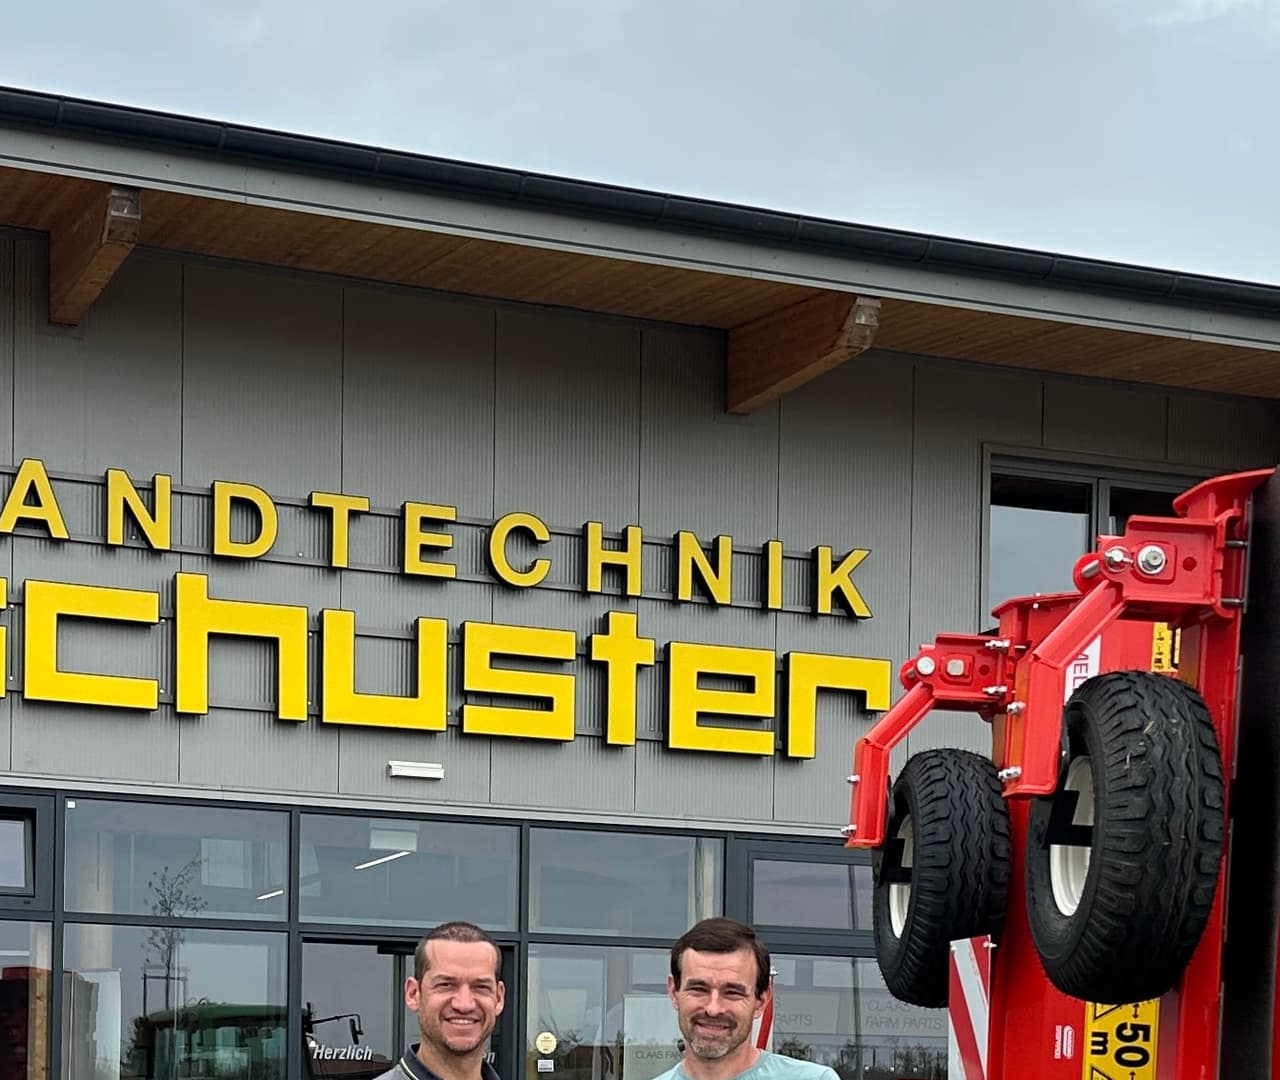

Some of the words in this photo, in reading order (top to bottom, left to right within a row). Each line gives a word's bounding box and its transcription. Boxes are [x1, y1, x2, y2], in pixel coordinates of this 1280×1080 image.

[865, 1016, 899, 1030] FARM
[903, 1017, 942, 1031] PARTS
[313, 1043, 373, 1061] Herzlich
[1090, 1031, 1109, 1056] m
[1115, 1021, 1151, 1068] 50
[635, 1051, 663, 1060] CLAAS
